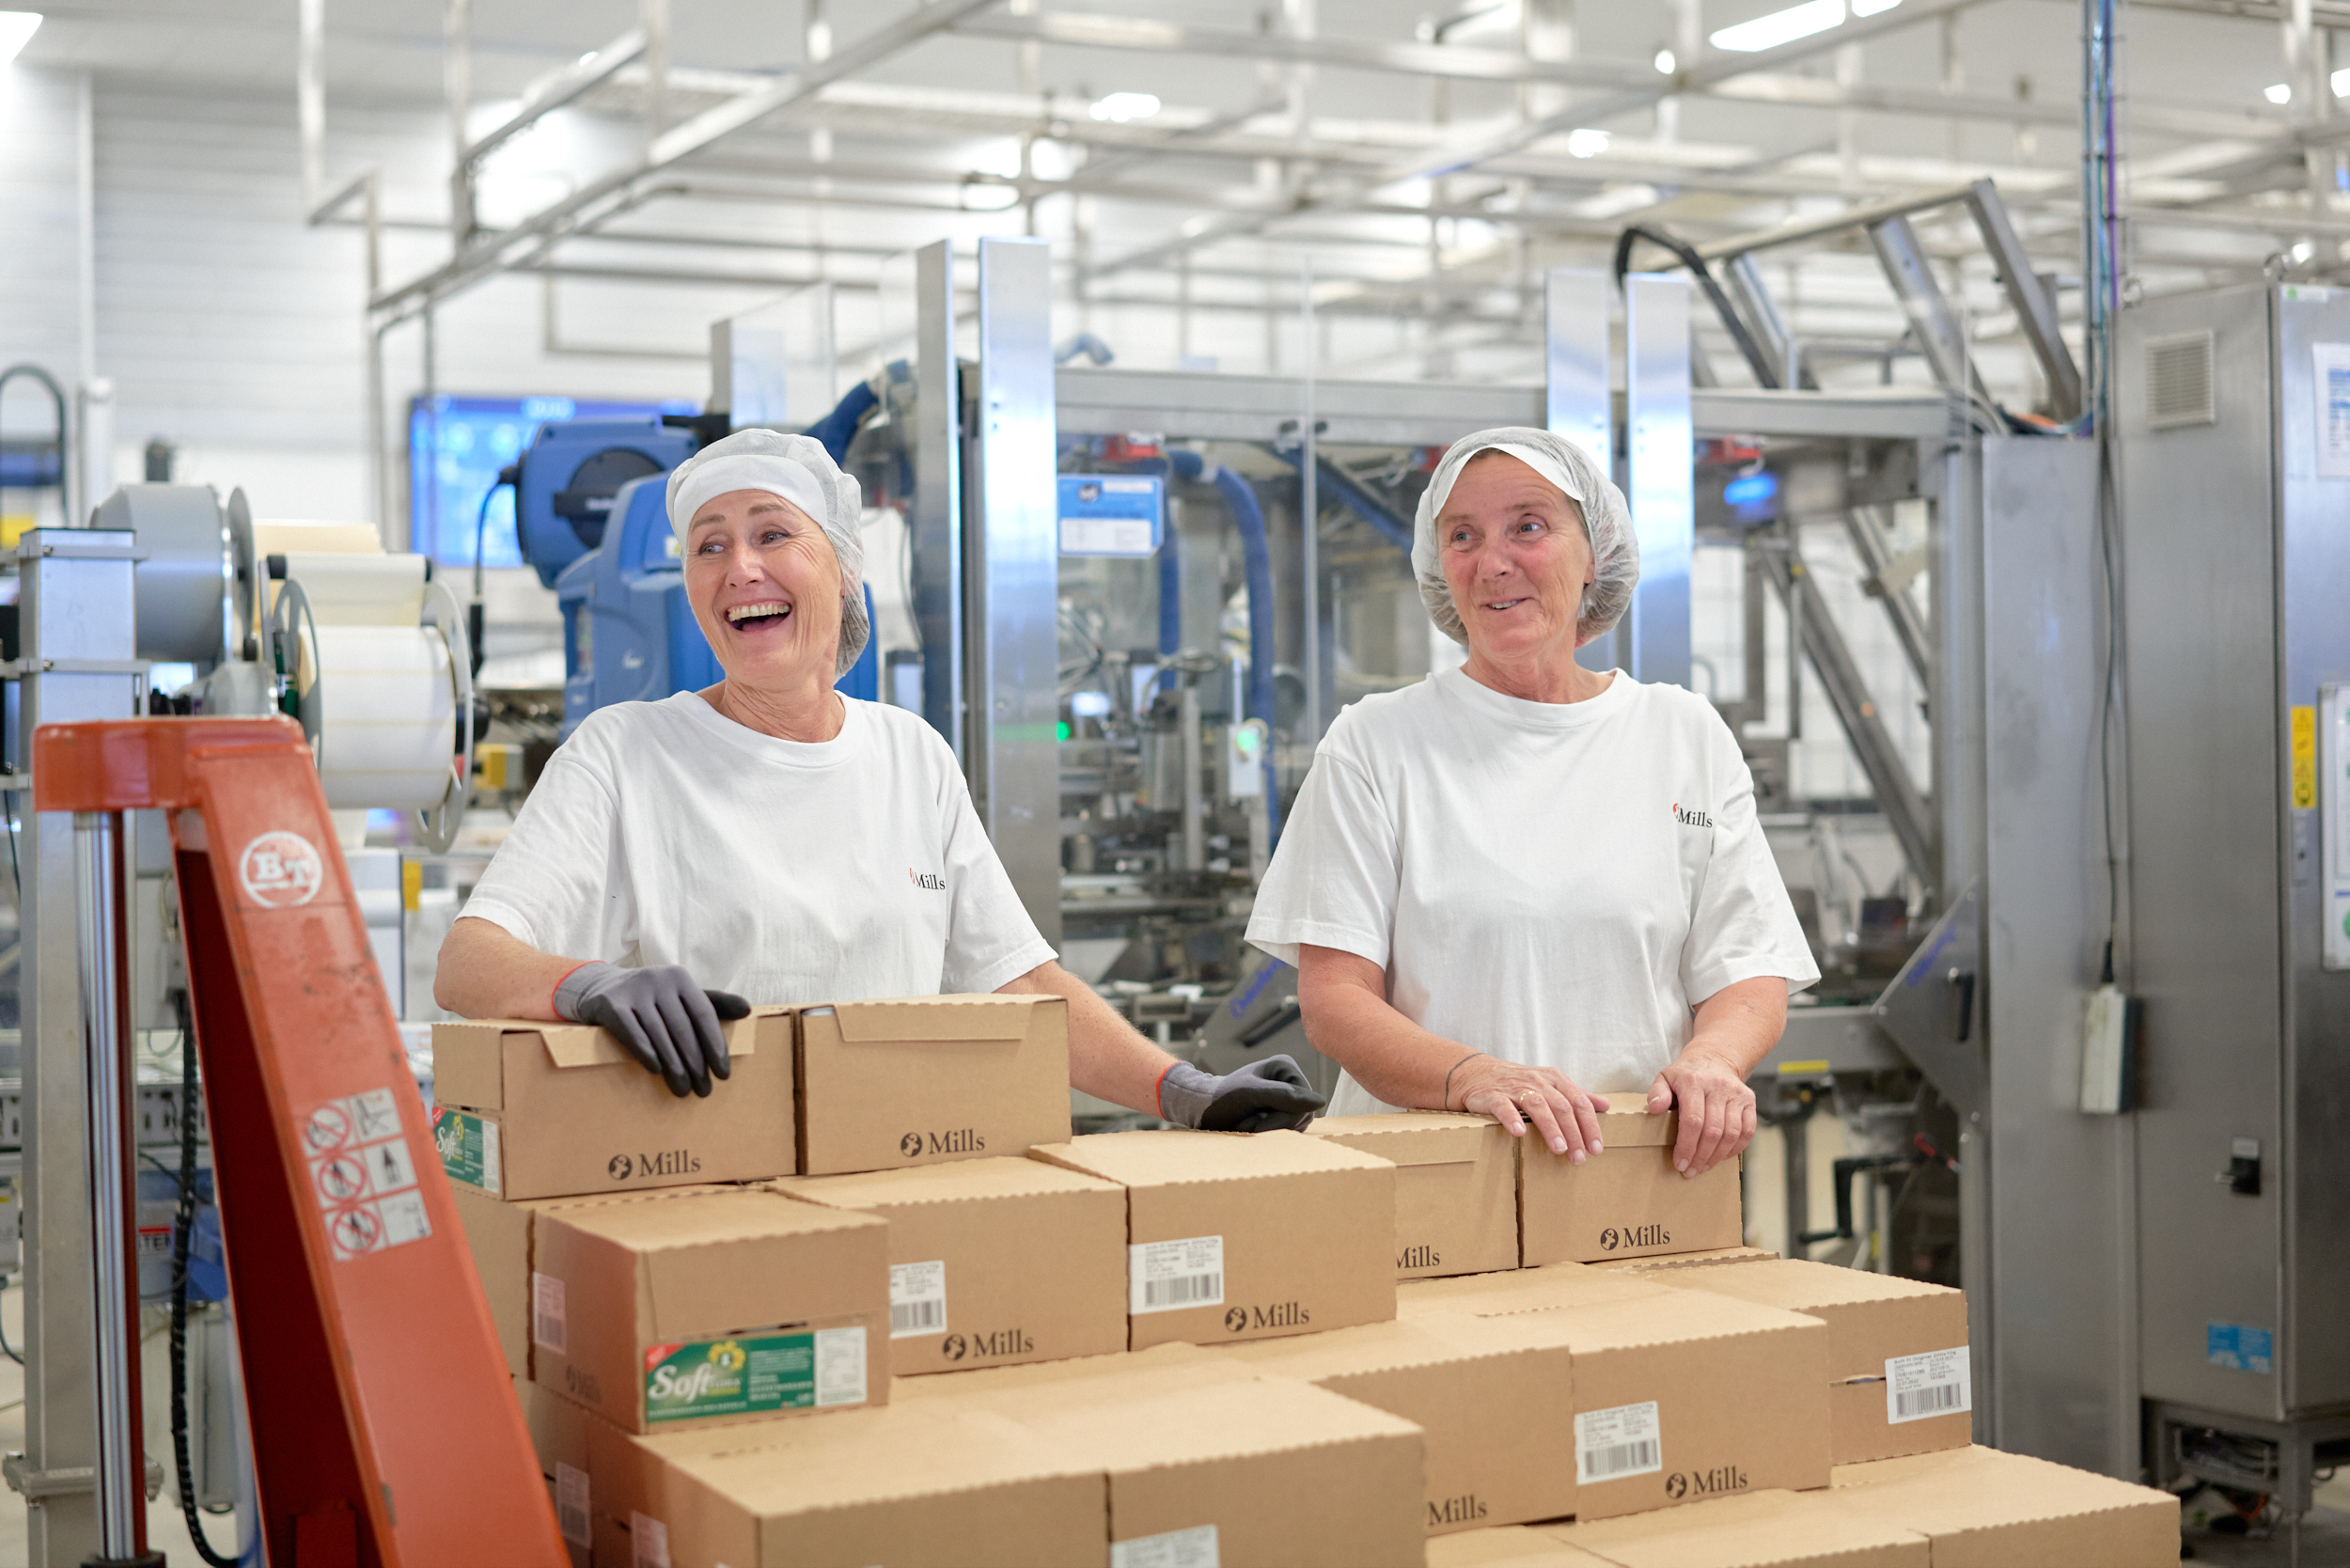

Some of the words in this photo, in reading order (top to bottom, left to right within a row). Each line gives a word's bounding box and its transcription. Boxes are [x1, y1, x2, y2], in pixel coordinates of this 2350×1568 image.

[1678, 808, 1713, 828] Mills
[253, 852, 311, 887] BT
[914, 871, 946, 890] Mills
[436, 1126, 456, 1162] Soft
[927, 1128, 985, 1154] Mills
[638, 1149, 701, 1178] Mills
[1622, 1224, 1670, 1248] Mills
[1252, 1300, 1310, 1329] Mills
[973, 1328, 1034, 1358] Mills
[648, 1362, 713, 1403] Soft
[1693, 1466, 1747, 1495] Mills
[1428, 1494, 1487, 1527] Mills
